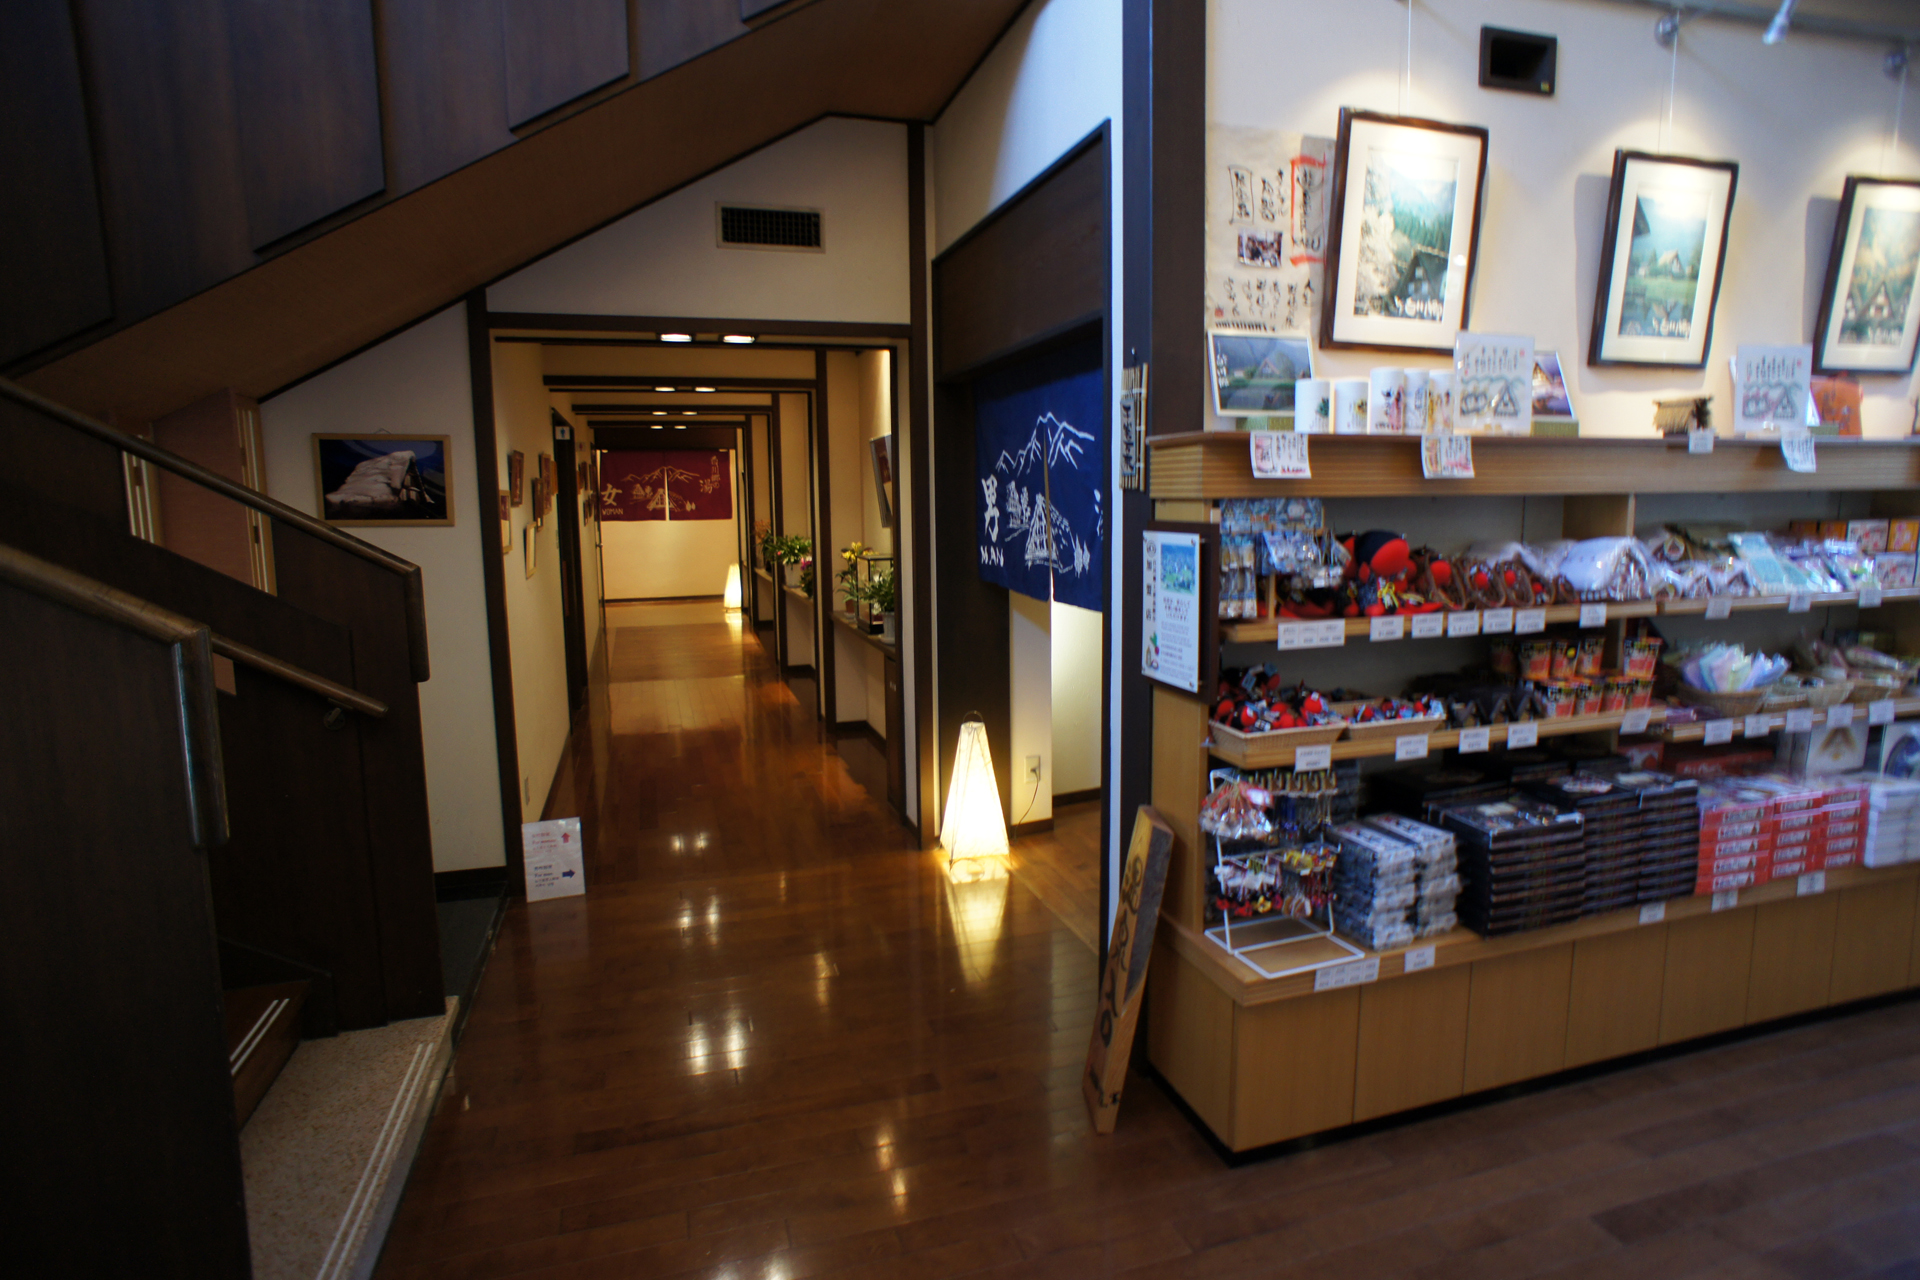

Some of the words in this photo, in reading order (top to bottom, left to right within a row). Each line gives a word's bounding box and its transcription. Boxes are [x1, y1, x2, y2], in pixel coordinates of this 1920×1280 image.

[600, 483, 623, 506] 女
[602, 507, 624, 516] WOMAN
[981, 473, 1000, 543] 男
[980, 545, 1005, 568] MAN
